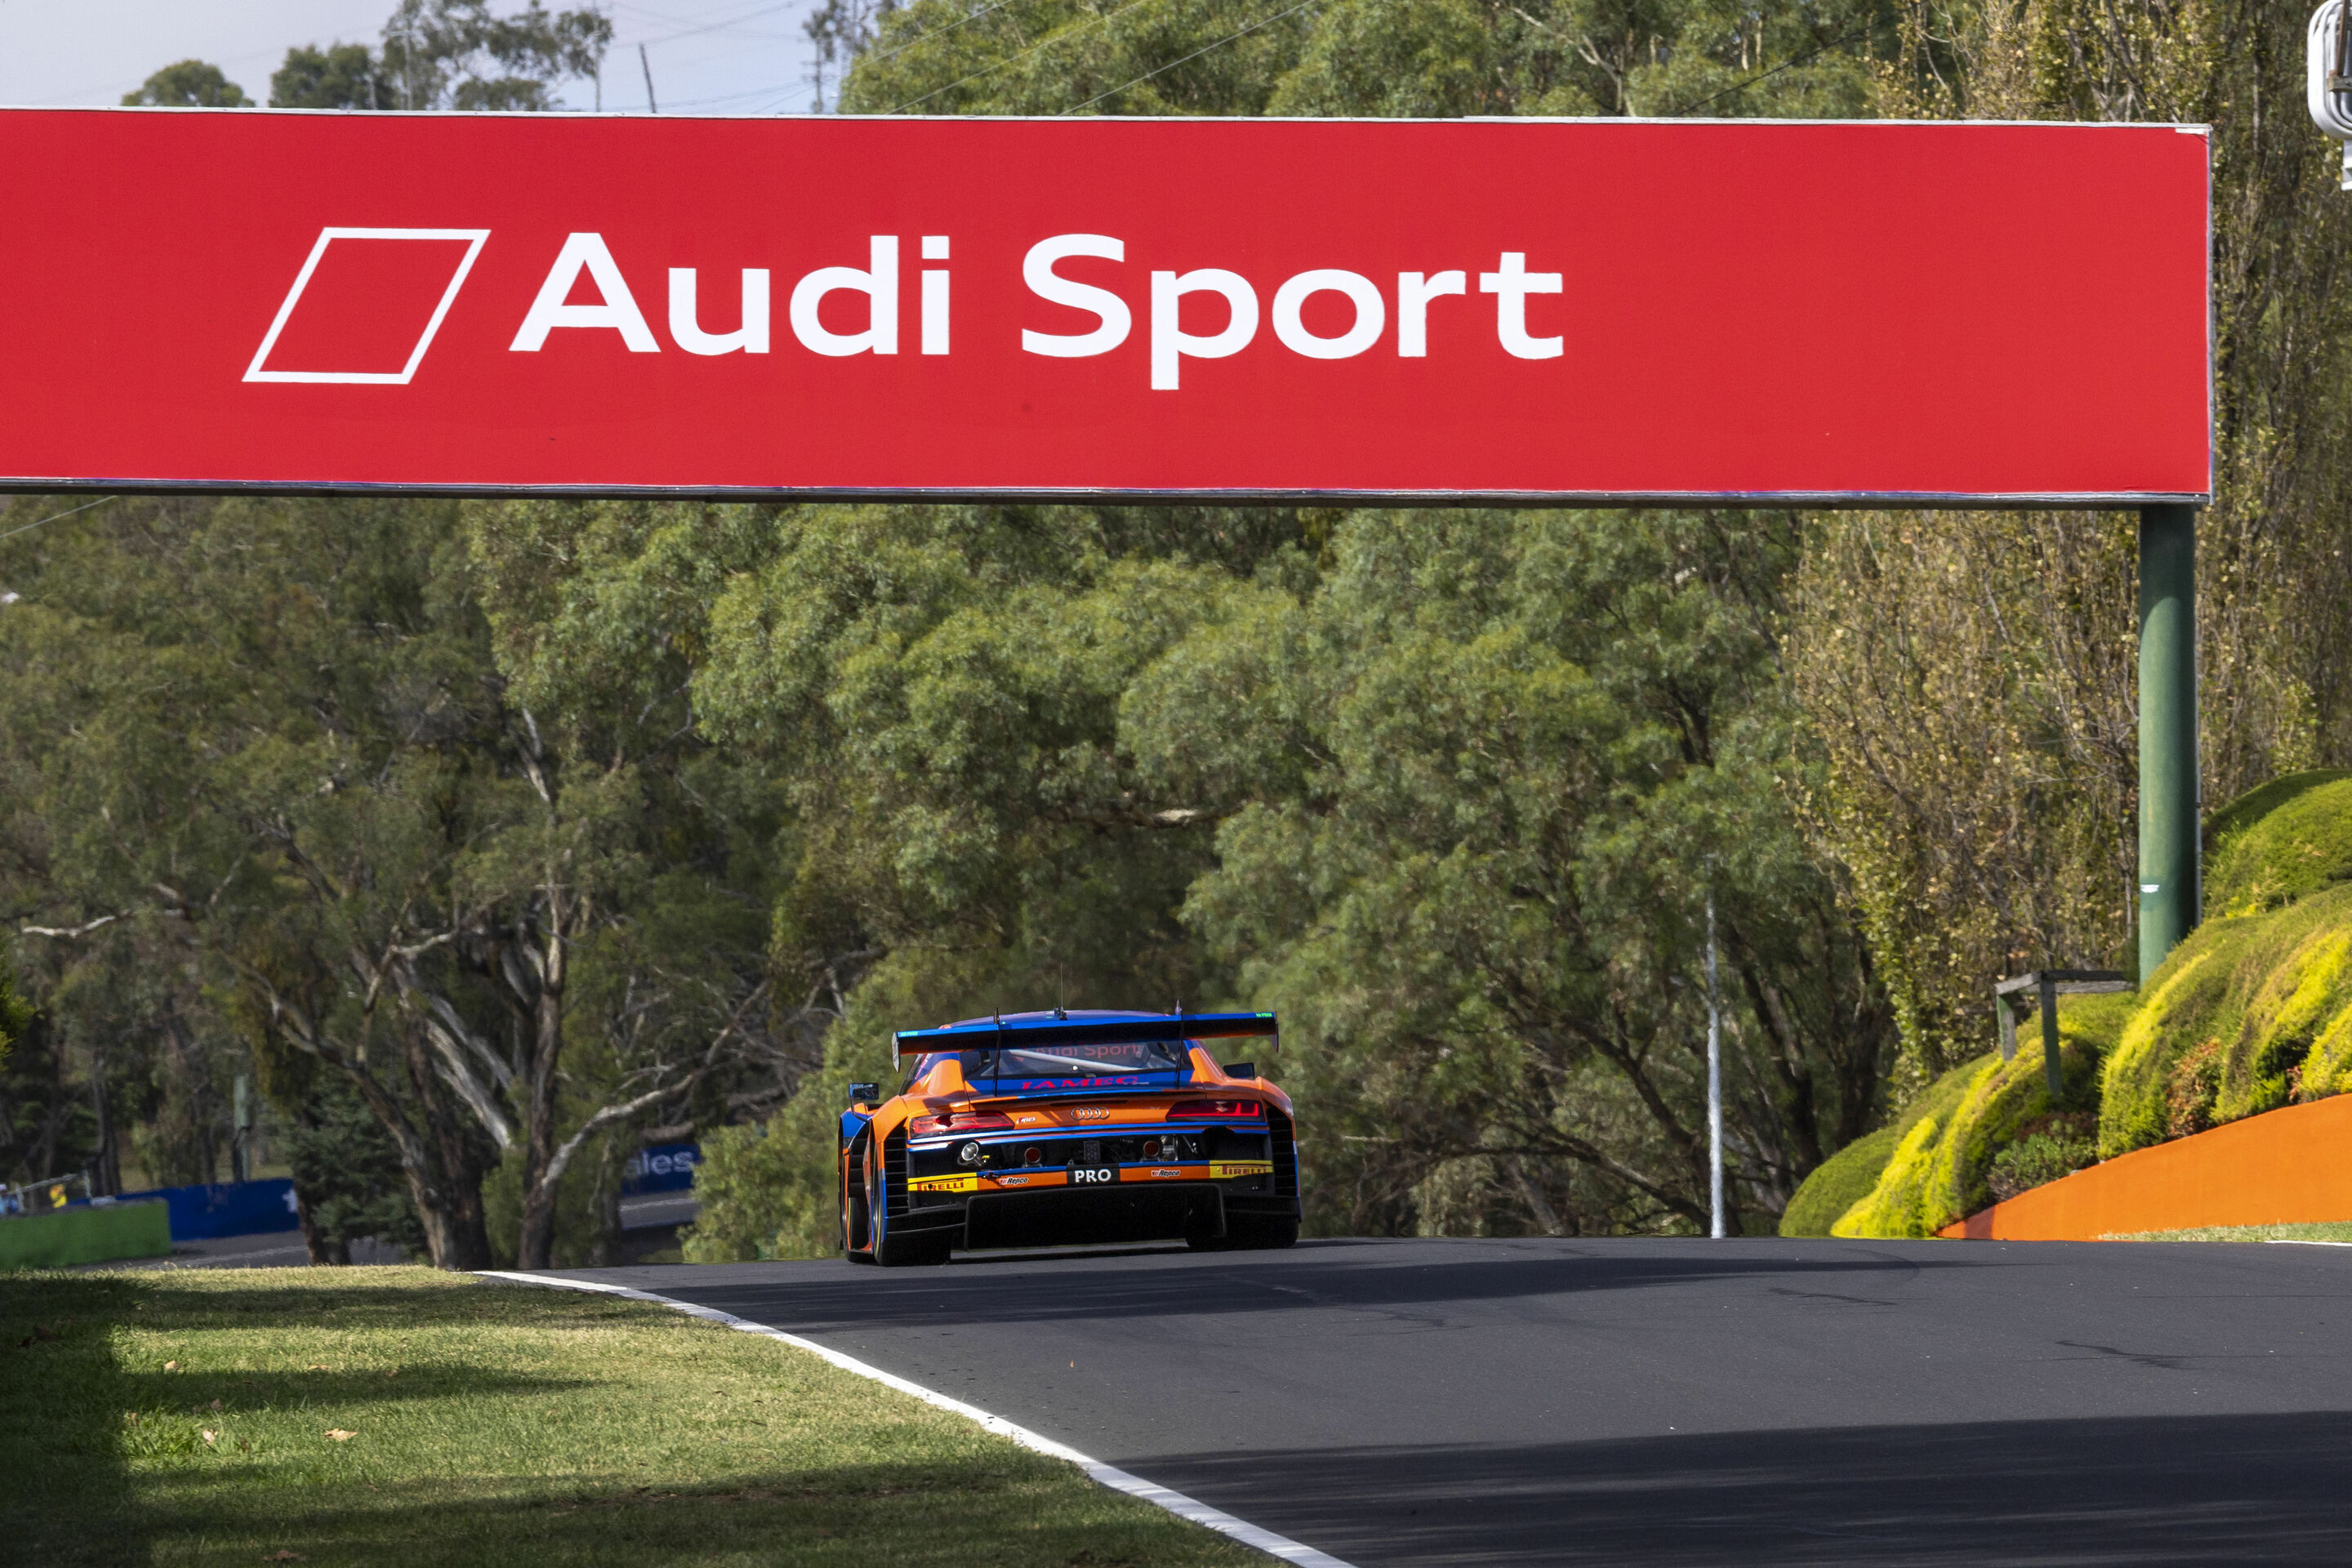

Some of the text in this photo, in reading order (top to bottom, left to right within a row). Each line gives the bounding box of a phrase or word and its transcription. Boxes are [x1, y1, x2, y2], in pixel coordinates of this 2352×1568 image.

[509, 232, 1565, 391] Audi Sport
[1035, 1046, 1078, 1057] udi
[1074, 1169, 1111, 1183] PRO
[1222, 1165, 1267, 1175] PIRELLI
